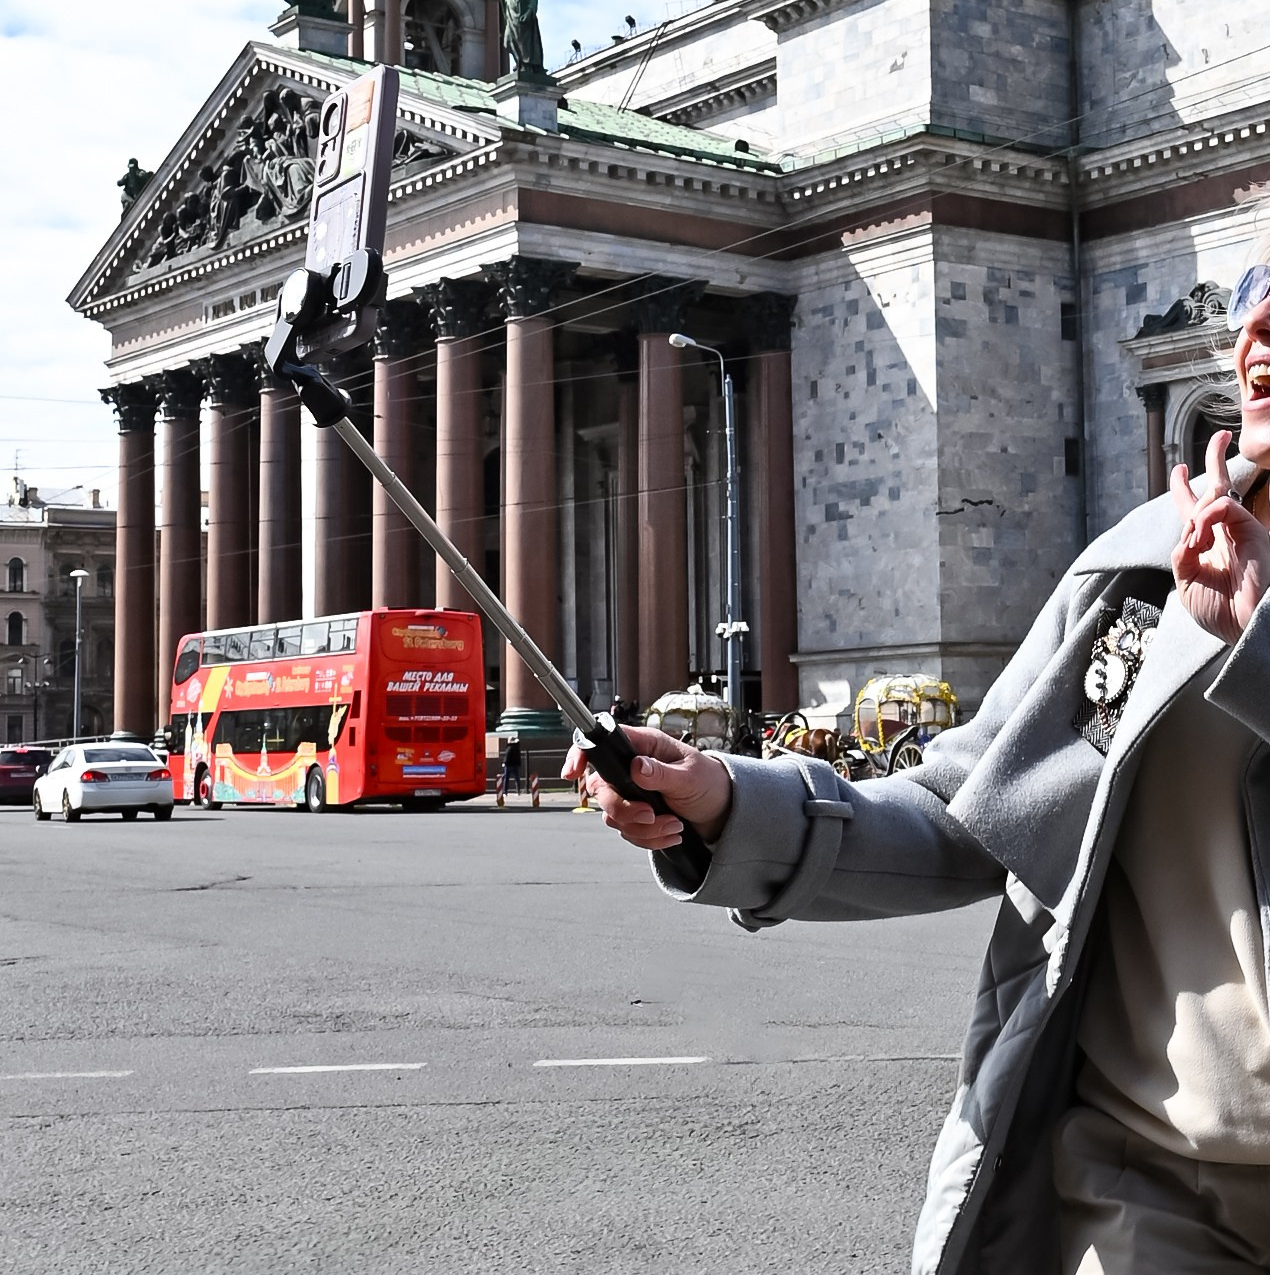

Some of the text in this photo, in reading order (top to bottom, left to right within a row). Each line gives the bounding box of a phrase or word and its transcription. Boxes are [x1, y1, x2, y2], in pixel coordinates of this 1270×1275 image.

[403, 671, 454, 682] МЕСТО ДЛЯ
[386, 681, 469, 693] ВАШЕЙ РЕКЛАМЫ
